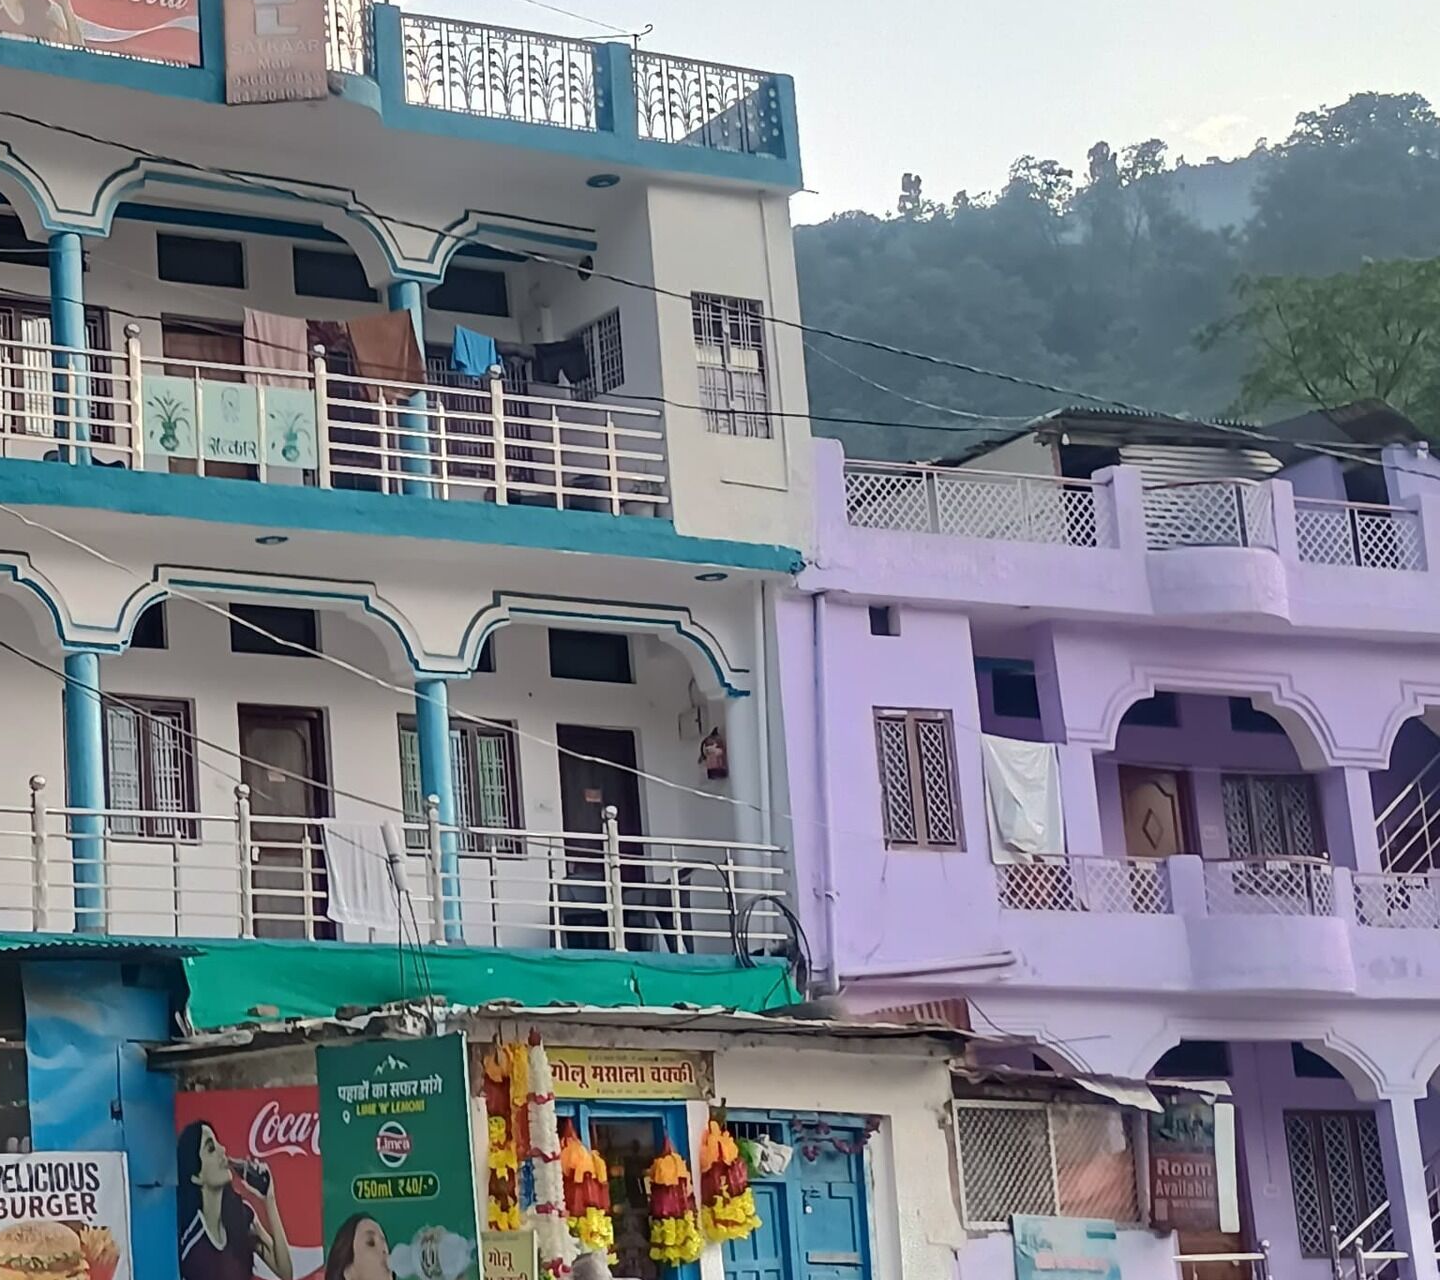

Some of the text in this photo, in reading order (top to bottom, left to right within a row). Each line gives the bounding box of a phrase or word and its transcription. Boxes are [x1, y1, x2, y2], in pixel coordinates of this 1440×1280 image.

[551, 1060, 694, 1088] गोलू मसाला चक्की
[376, 1136, 410, 1151] Limca
[1157, 1159, 1211, 1177] Room
[357, 1179, 393, 1199] 750ml
[1156, 1179, 1214, 1198] Available
[488, 1247, 514, 1272] गोलू
